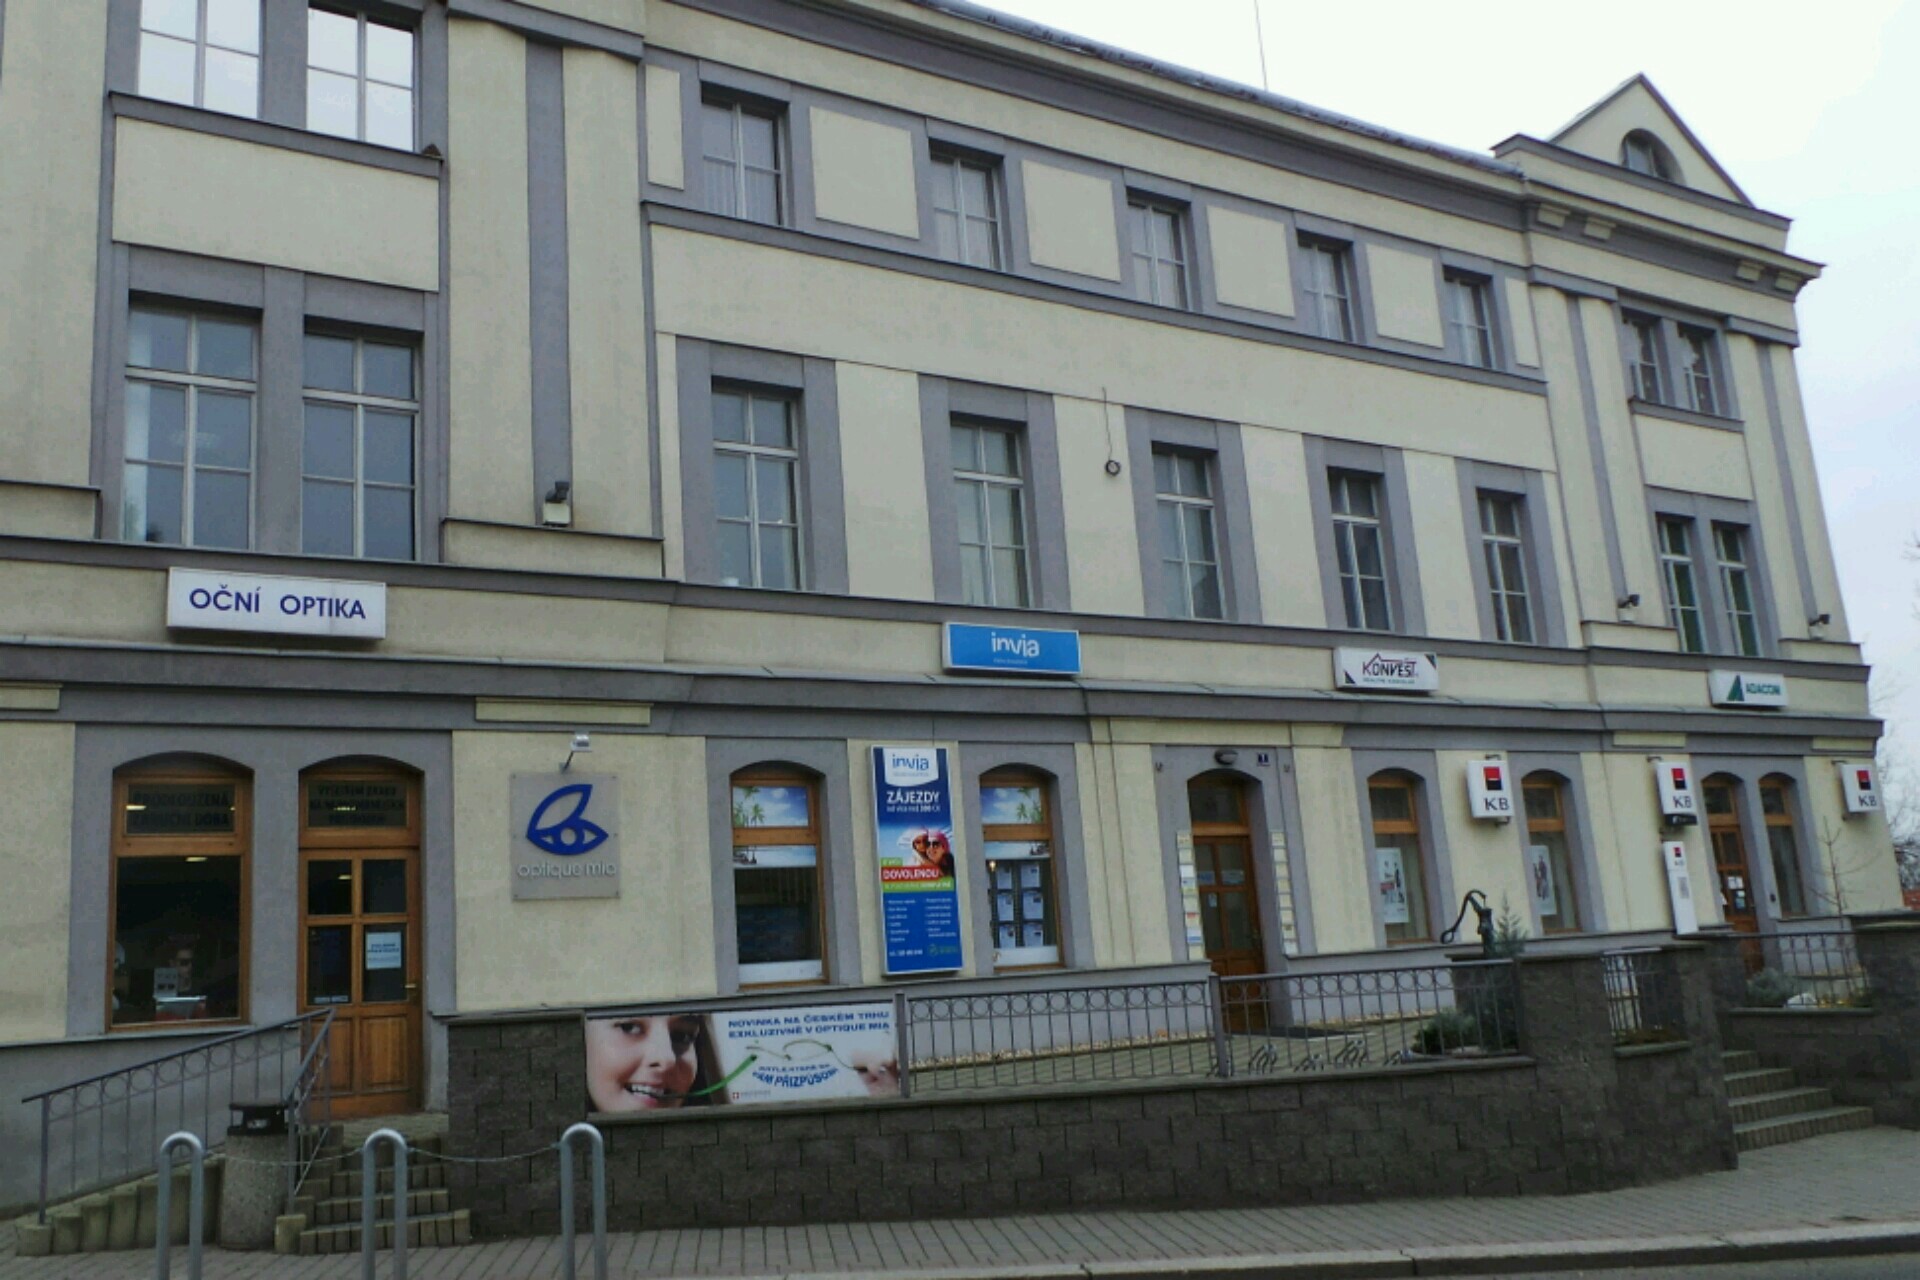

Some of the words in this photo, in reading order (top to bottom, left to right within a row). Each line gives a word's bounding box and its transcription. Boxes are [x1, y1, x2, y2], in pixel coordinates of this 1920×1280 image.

[189, 584, 261, 613] OČNÍ
[280, 594, 366, 619] OPTIKA
[991, 631, 1039, 657] invia
[892, 754, 930, 771] invia
[886, 788, 940, 805] ZÁJEZDY
[1485, 797, 1509, 811] KB
[1673, 795, 1692, 808] KB
[1859, 795, 1877, 807] KB
[728, 1018, 781, 1029] NOVINKA
[784, 1016, 801, 1025] NA
[857, 1011, 890, 1020] TRHU
[815, 1023, 866, 1033] OPTIQUE
[868, 1021, 890, 1031] MIA
